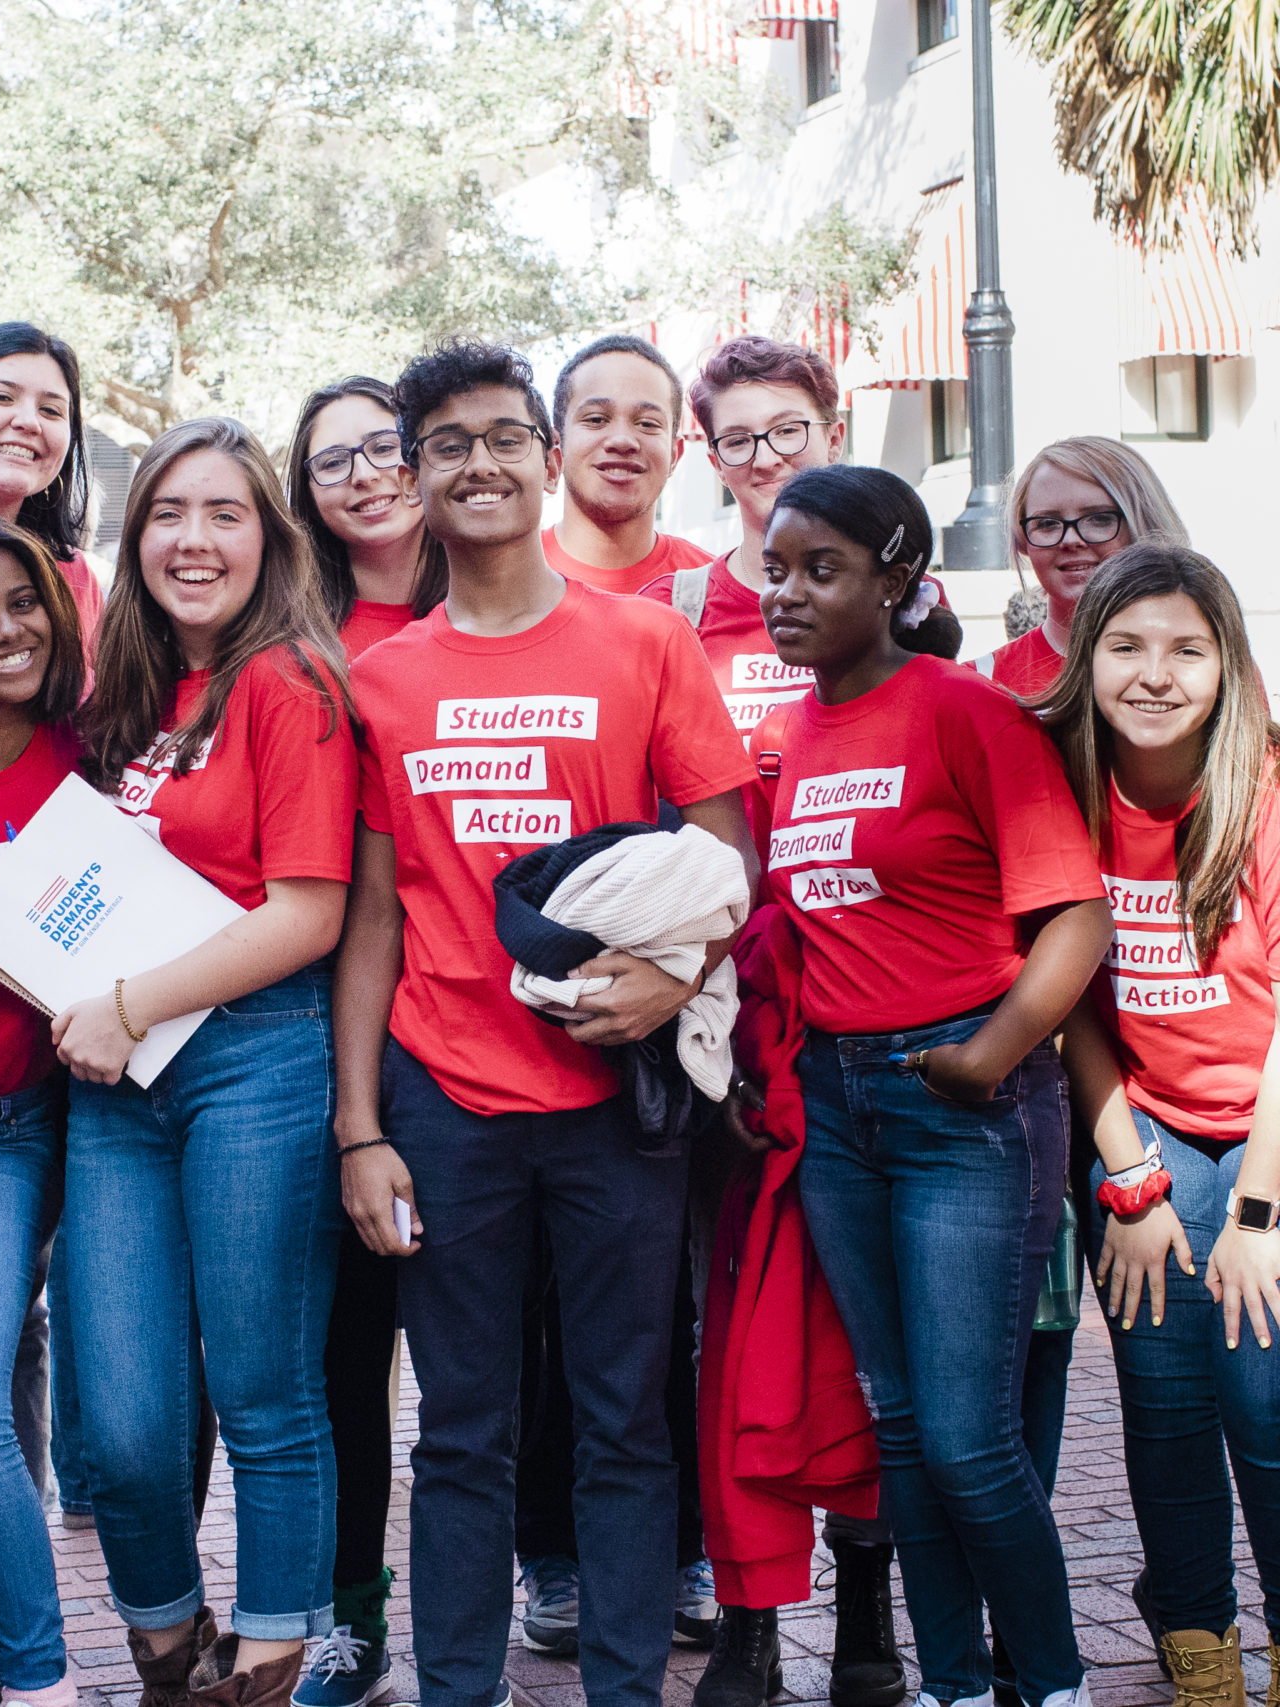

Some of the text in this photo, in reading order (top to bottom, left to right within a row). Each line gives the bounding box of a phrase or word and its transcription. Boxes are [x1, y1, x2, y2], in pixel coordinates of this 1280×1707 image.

[449, 704, 585, 730] Students
[416, 753, 532, 784] Demand
[801, 778, 893, 809] Students
[465, 807, 561, 834] Action
[769, 825, 846, 861] Demand
[39, 862, 102, 933] STUDENTS
[49, 884, 101, 942] DEMAND
[61, 899, 106, 951] ACTION
[1125, 985, 1216, 1008] Action
